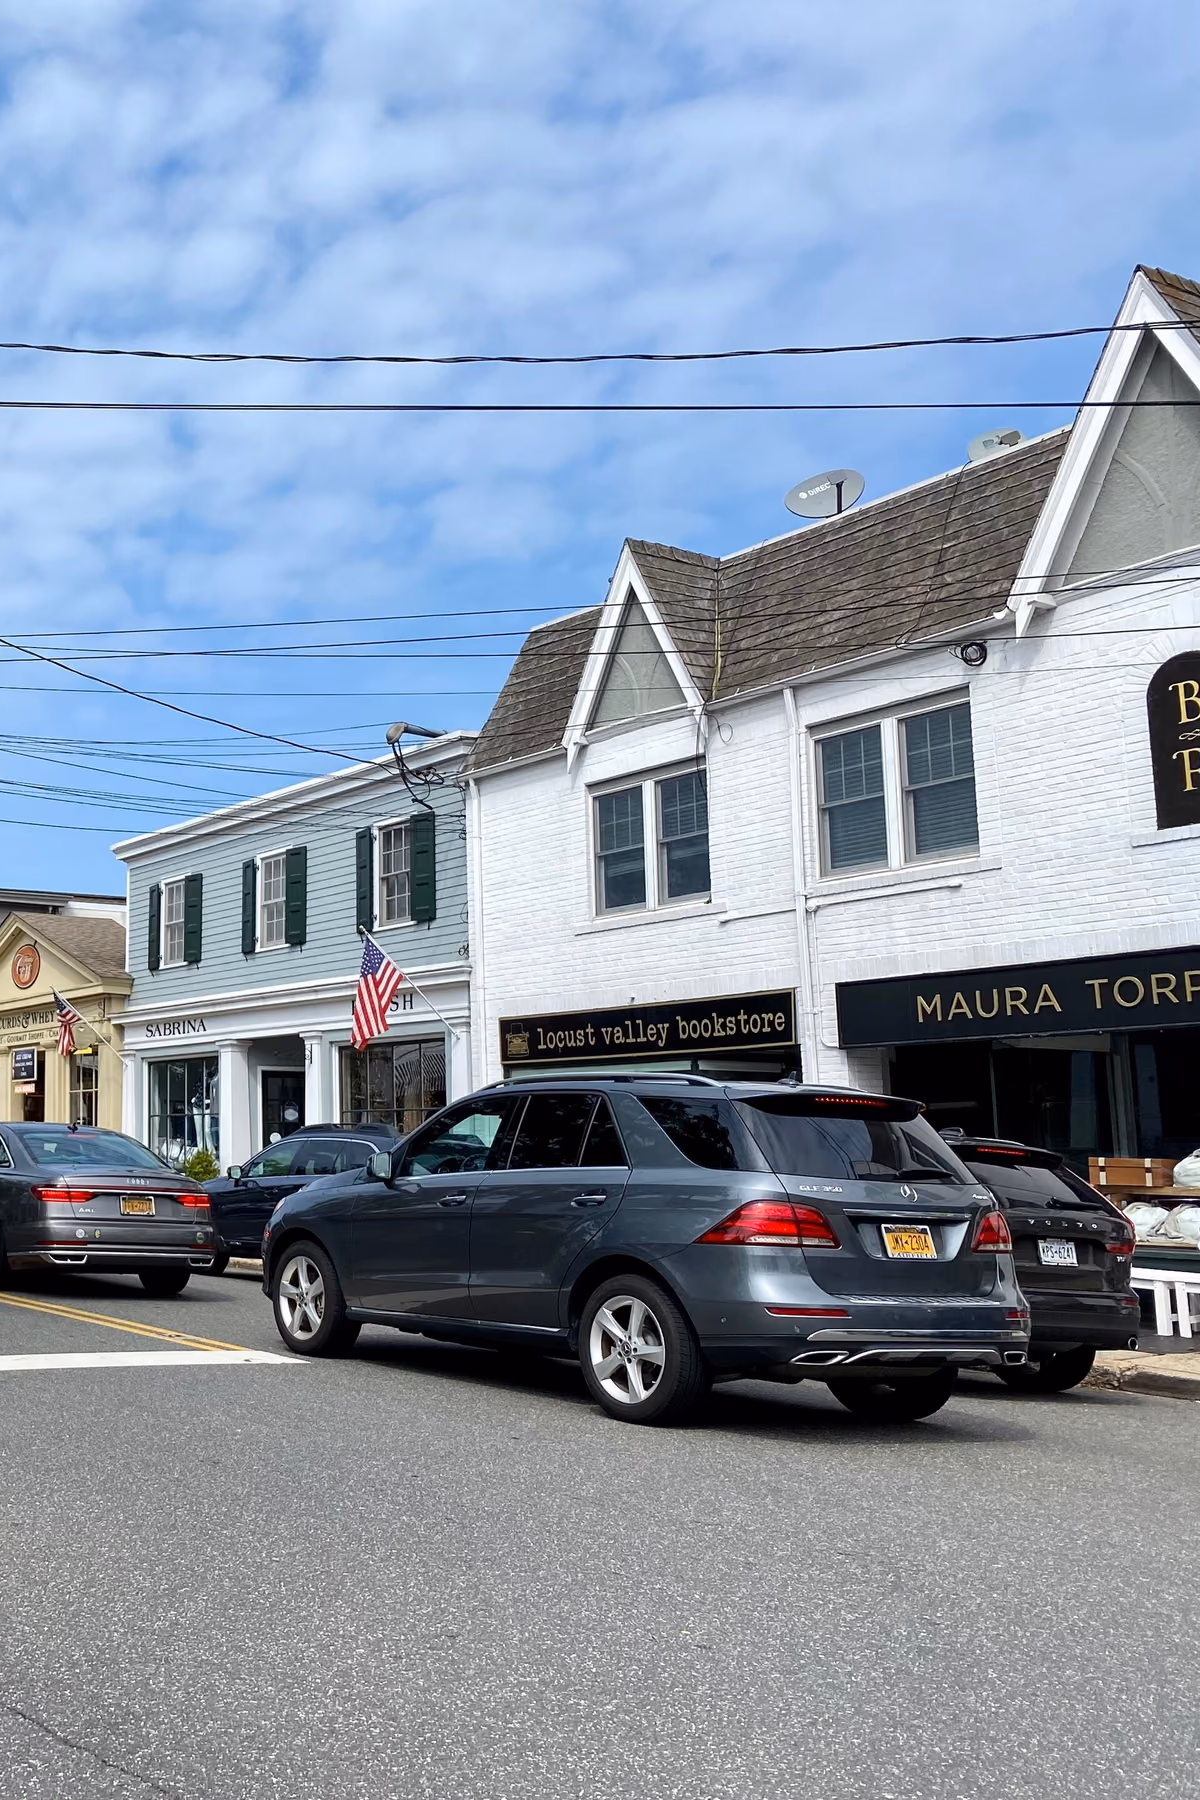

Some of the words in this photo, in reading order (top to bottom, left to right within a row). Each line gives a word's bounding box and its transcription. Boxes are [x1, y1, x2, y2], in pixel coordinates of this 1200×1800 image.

[916, 983, 1062, 1023] MAURA
[31, 1010, 55, 1024] WHEY
[145, 1018, 207, 1038] SABRINA
[537, 1023, 595, 1049] locust
[601, 1020, 669, 1047] valley
[676, 1009, 786, 1039] bookstore
[1028, 1219, 1097, 1229] VOLVO
